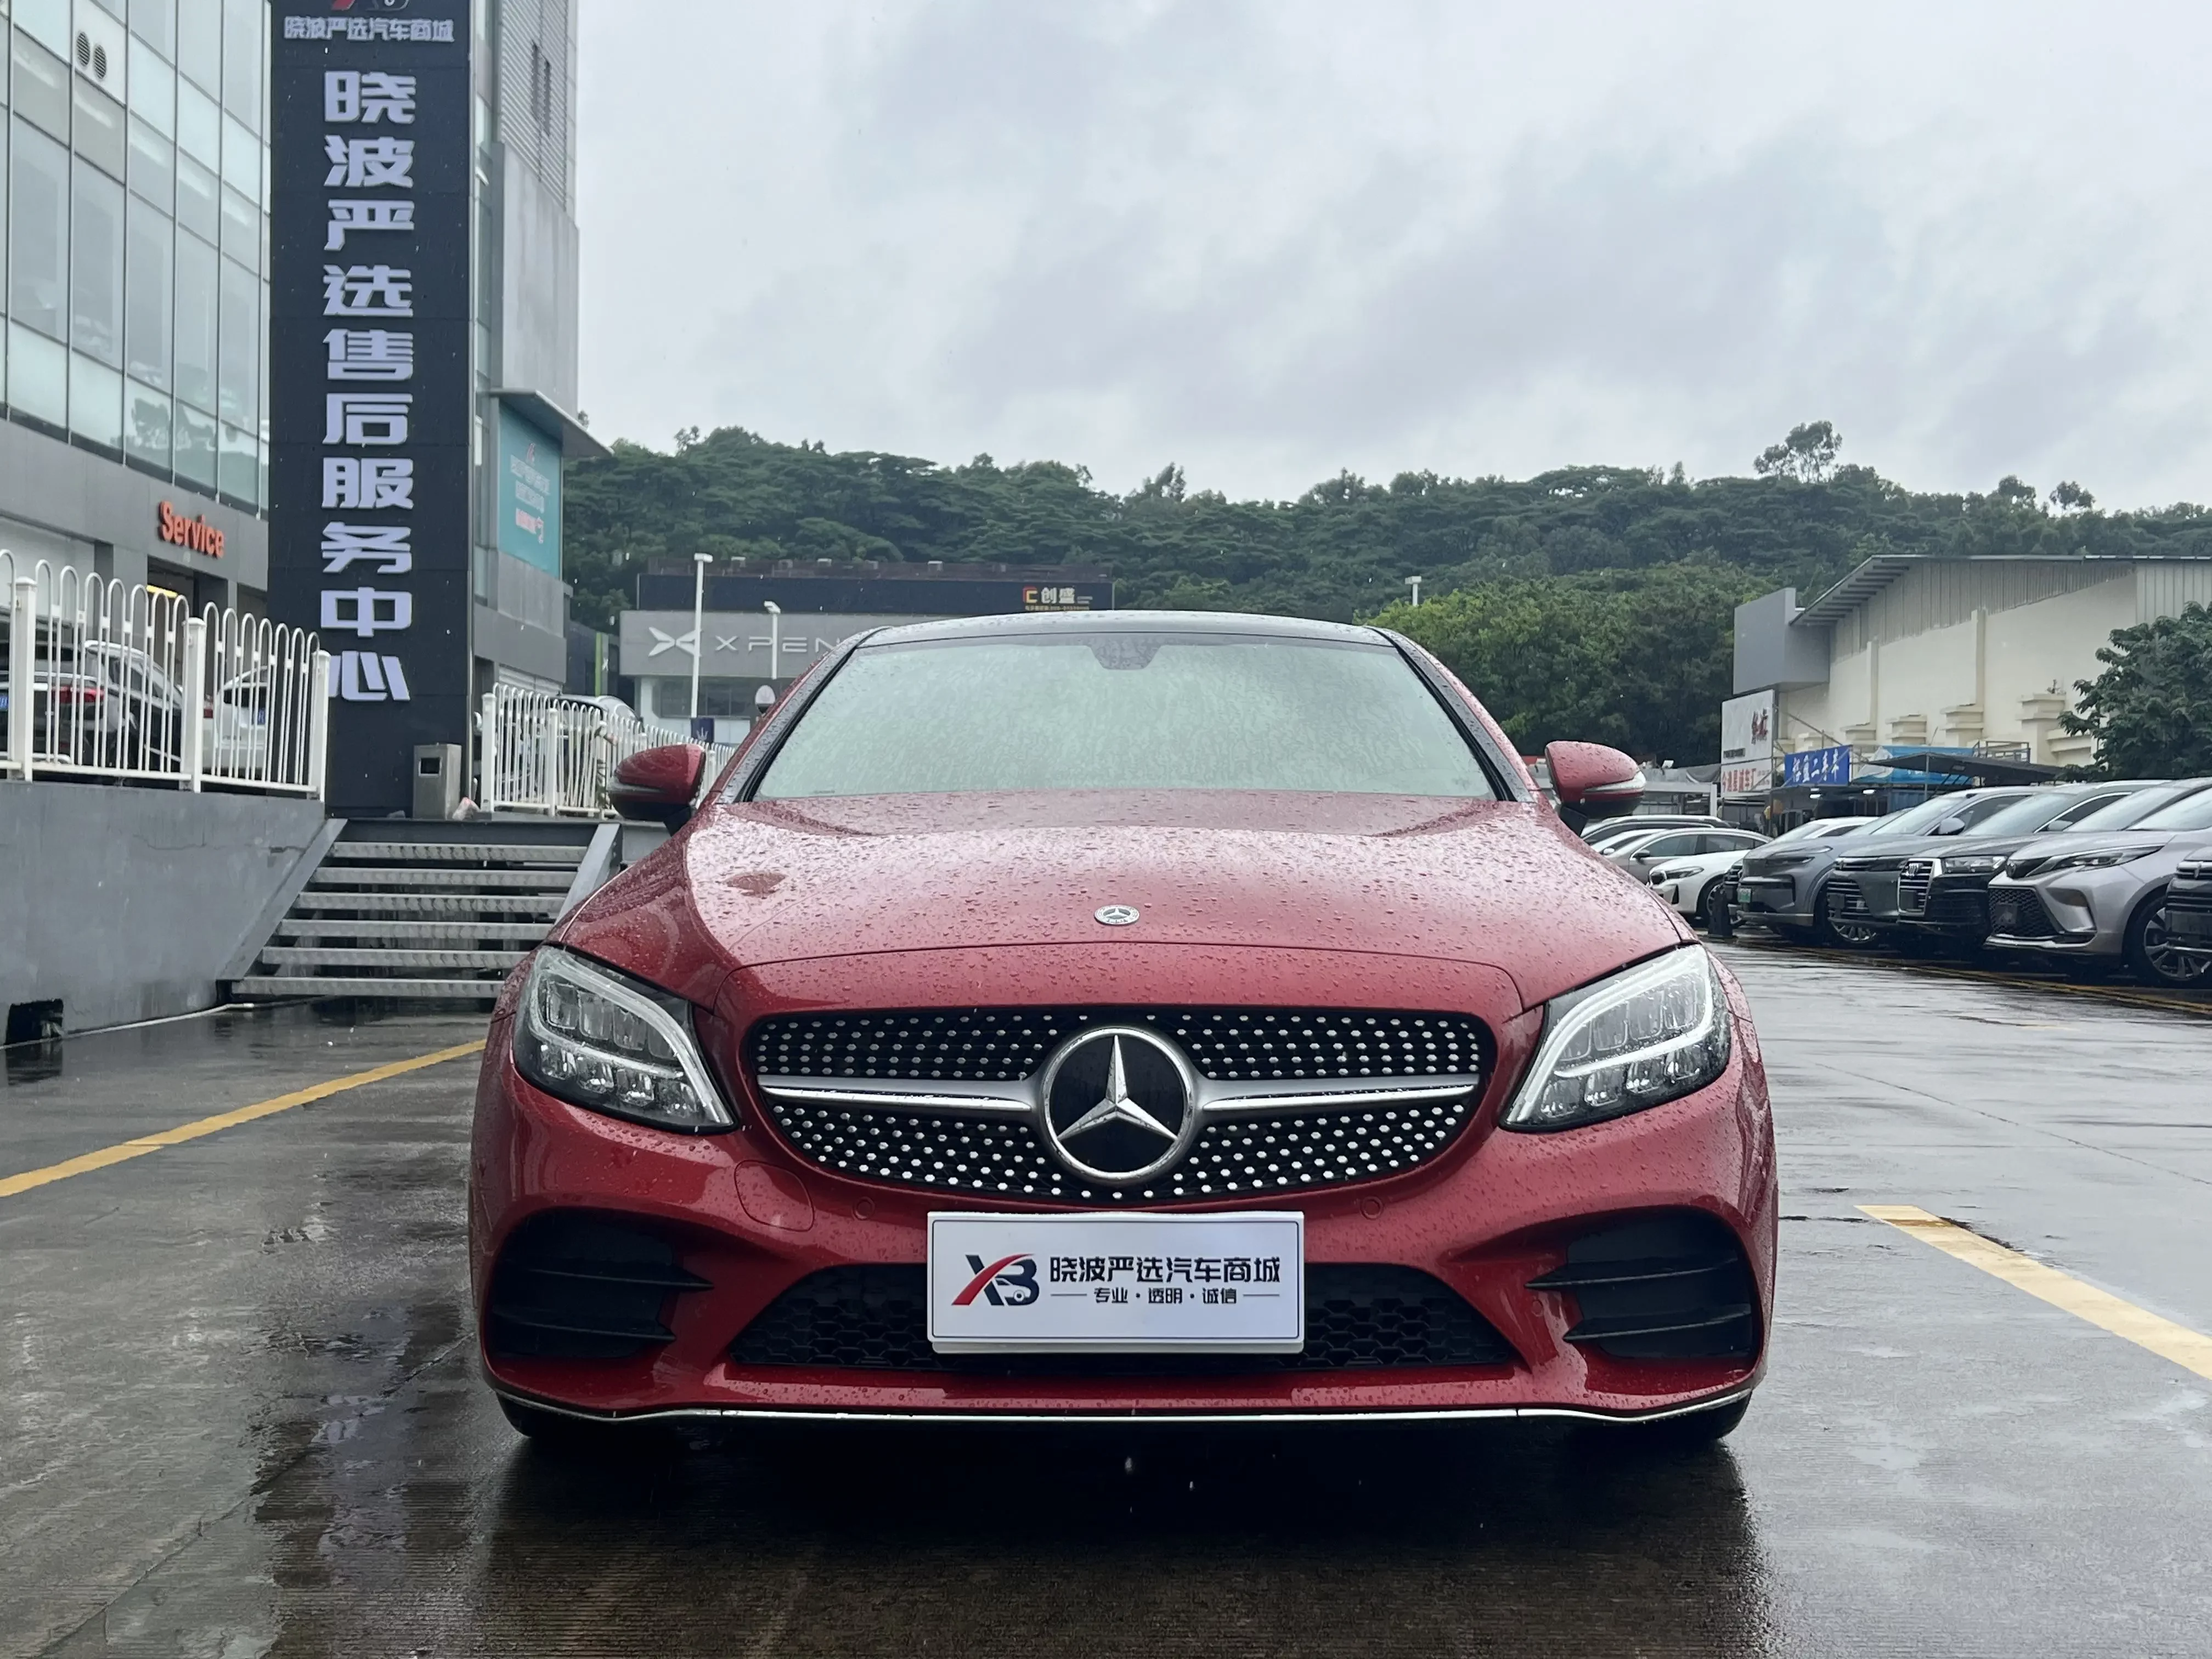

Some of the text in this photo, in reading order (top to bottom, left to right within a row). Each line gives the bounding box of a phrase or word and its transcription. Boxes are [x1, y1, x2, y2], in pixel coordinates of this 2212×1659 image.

[284, 16, 455, 42] 晓波严选汽车商城
[321, 70, 416, 701] 晓波严选售后服务中心
[159, 500, 224, 558] Service
[1049, 1256, 1280, 1283] 晓波严选汽车商城
